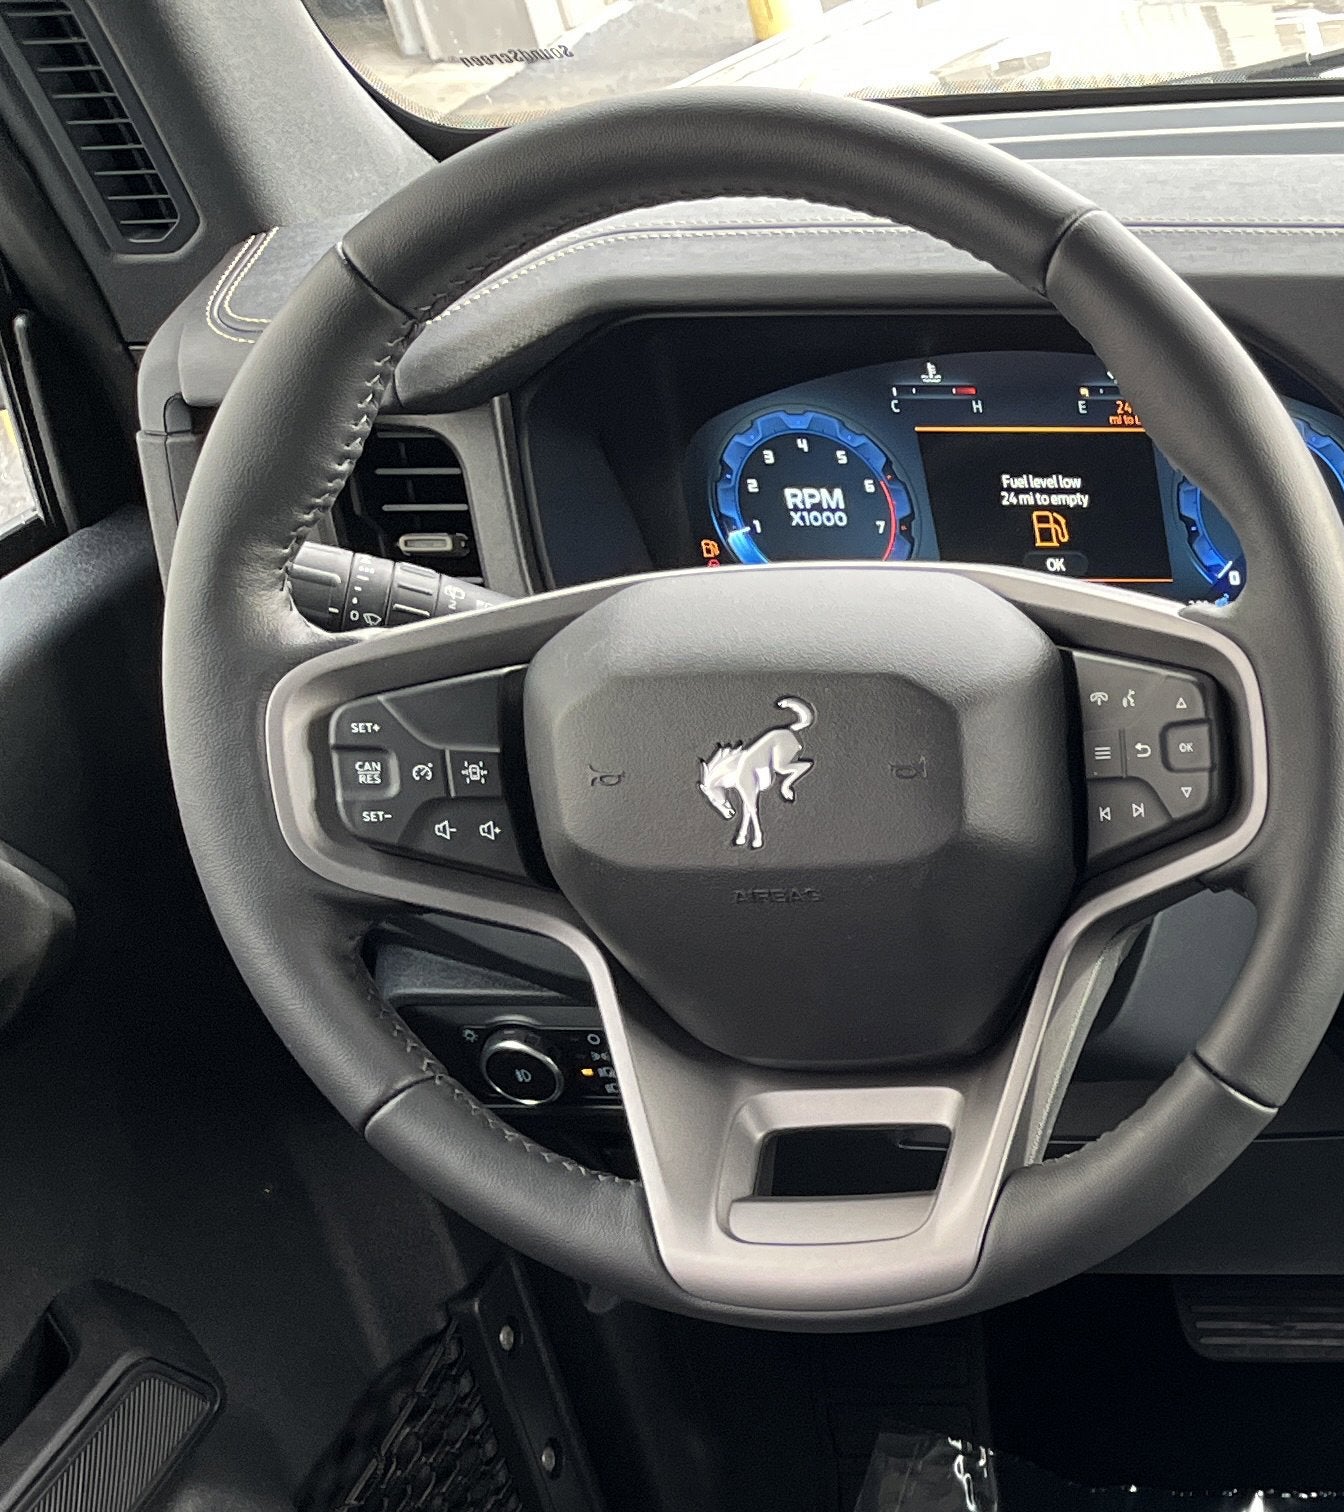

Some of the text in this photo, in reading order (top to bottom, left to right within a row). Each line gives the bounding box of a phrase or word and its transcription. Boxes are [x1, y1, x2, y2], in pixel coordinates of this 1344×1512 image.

[1116, 400, 1132, 414] 24
[796, 438, 809, 452] 4
[763, 450, 775, 465] 3
[836, 450, 848, 465] 5
[747, 478, 759, 493] 2
[864, 479, 875, 493] 6
[1001, 474, 1081, 489] Fuel level low
[783, 487, 845, 510] RPM
[1000, 492, 1089, 508] 24 mi to empty
[753, 519, 762, 533] 1
[790, 511, 848, 527] X1000
[876, 520, 885, 534] 7
[1046, 558, 1066, 573] OK
[351, 722, 381, 734] SET+
[1178, 742, 1194, 752] OK
[354, 761, 382, 773] CAN
[358, 773, 382, 785] RES
[362, 810, 392, 822] SET-
